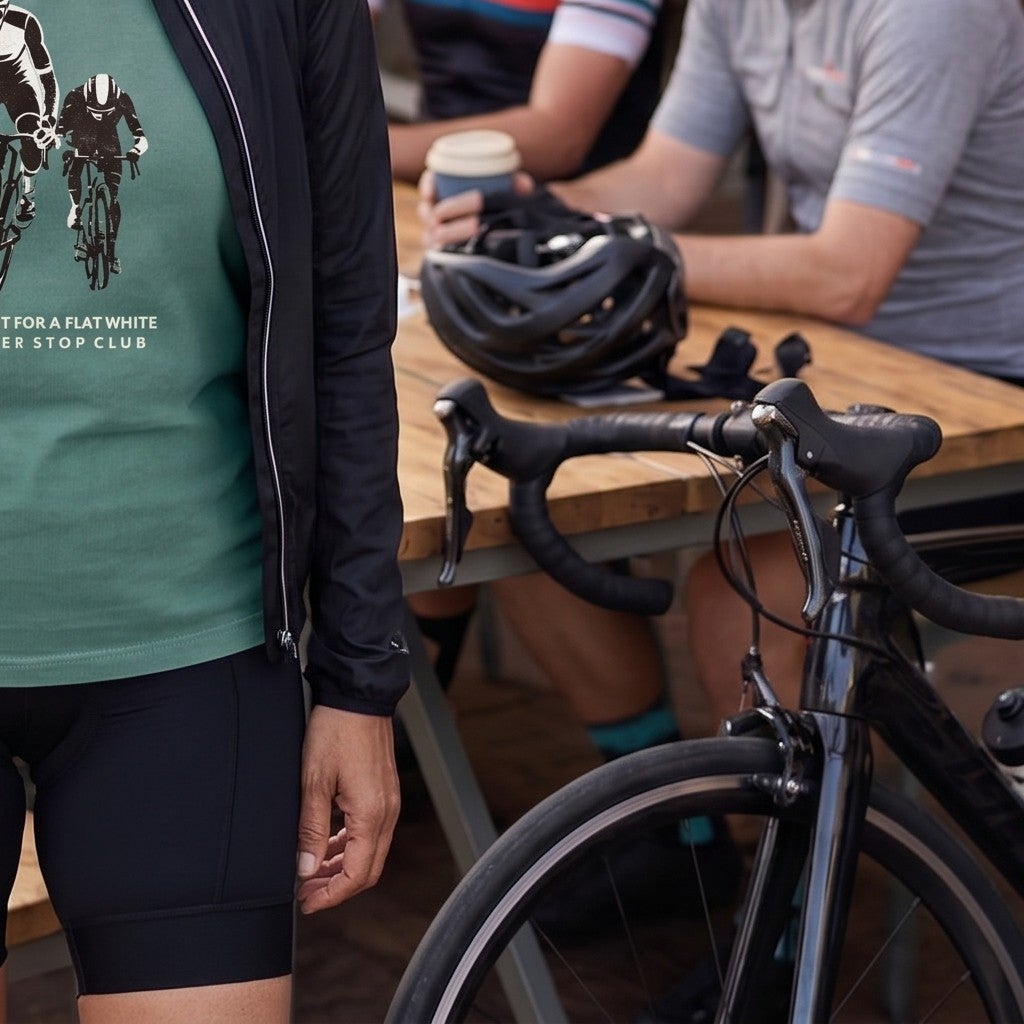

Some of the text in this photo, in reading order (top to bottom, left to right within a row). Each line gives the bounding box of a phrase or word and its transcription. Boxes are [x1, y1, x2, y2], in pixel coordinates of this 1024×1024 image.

[14, 316, 47, 329] FOR
[49, 316, 61, 329] A
[65, 316, 103, 329] FLAT
[104, 316, 158, 329] WHITE
[33, 336, 85, 349] STOP
[93, 336, 146, 349] CLUB
